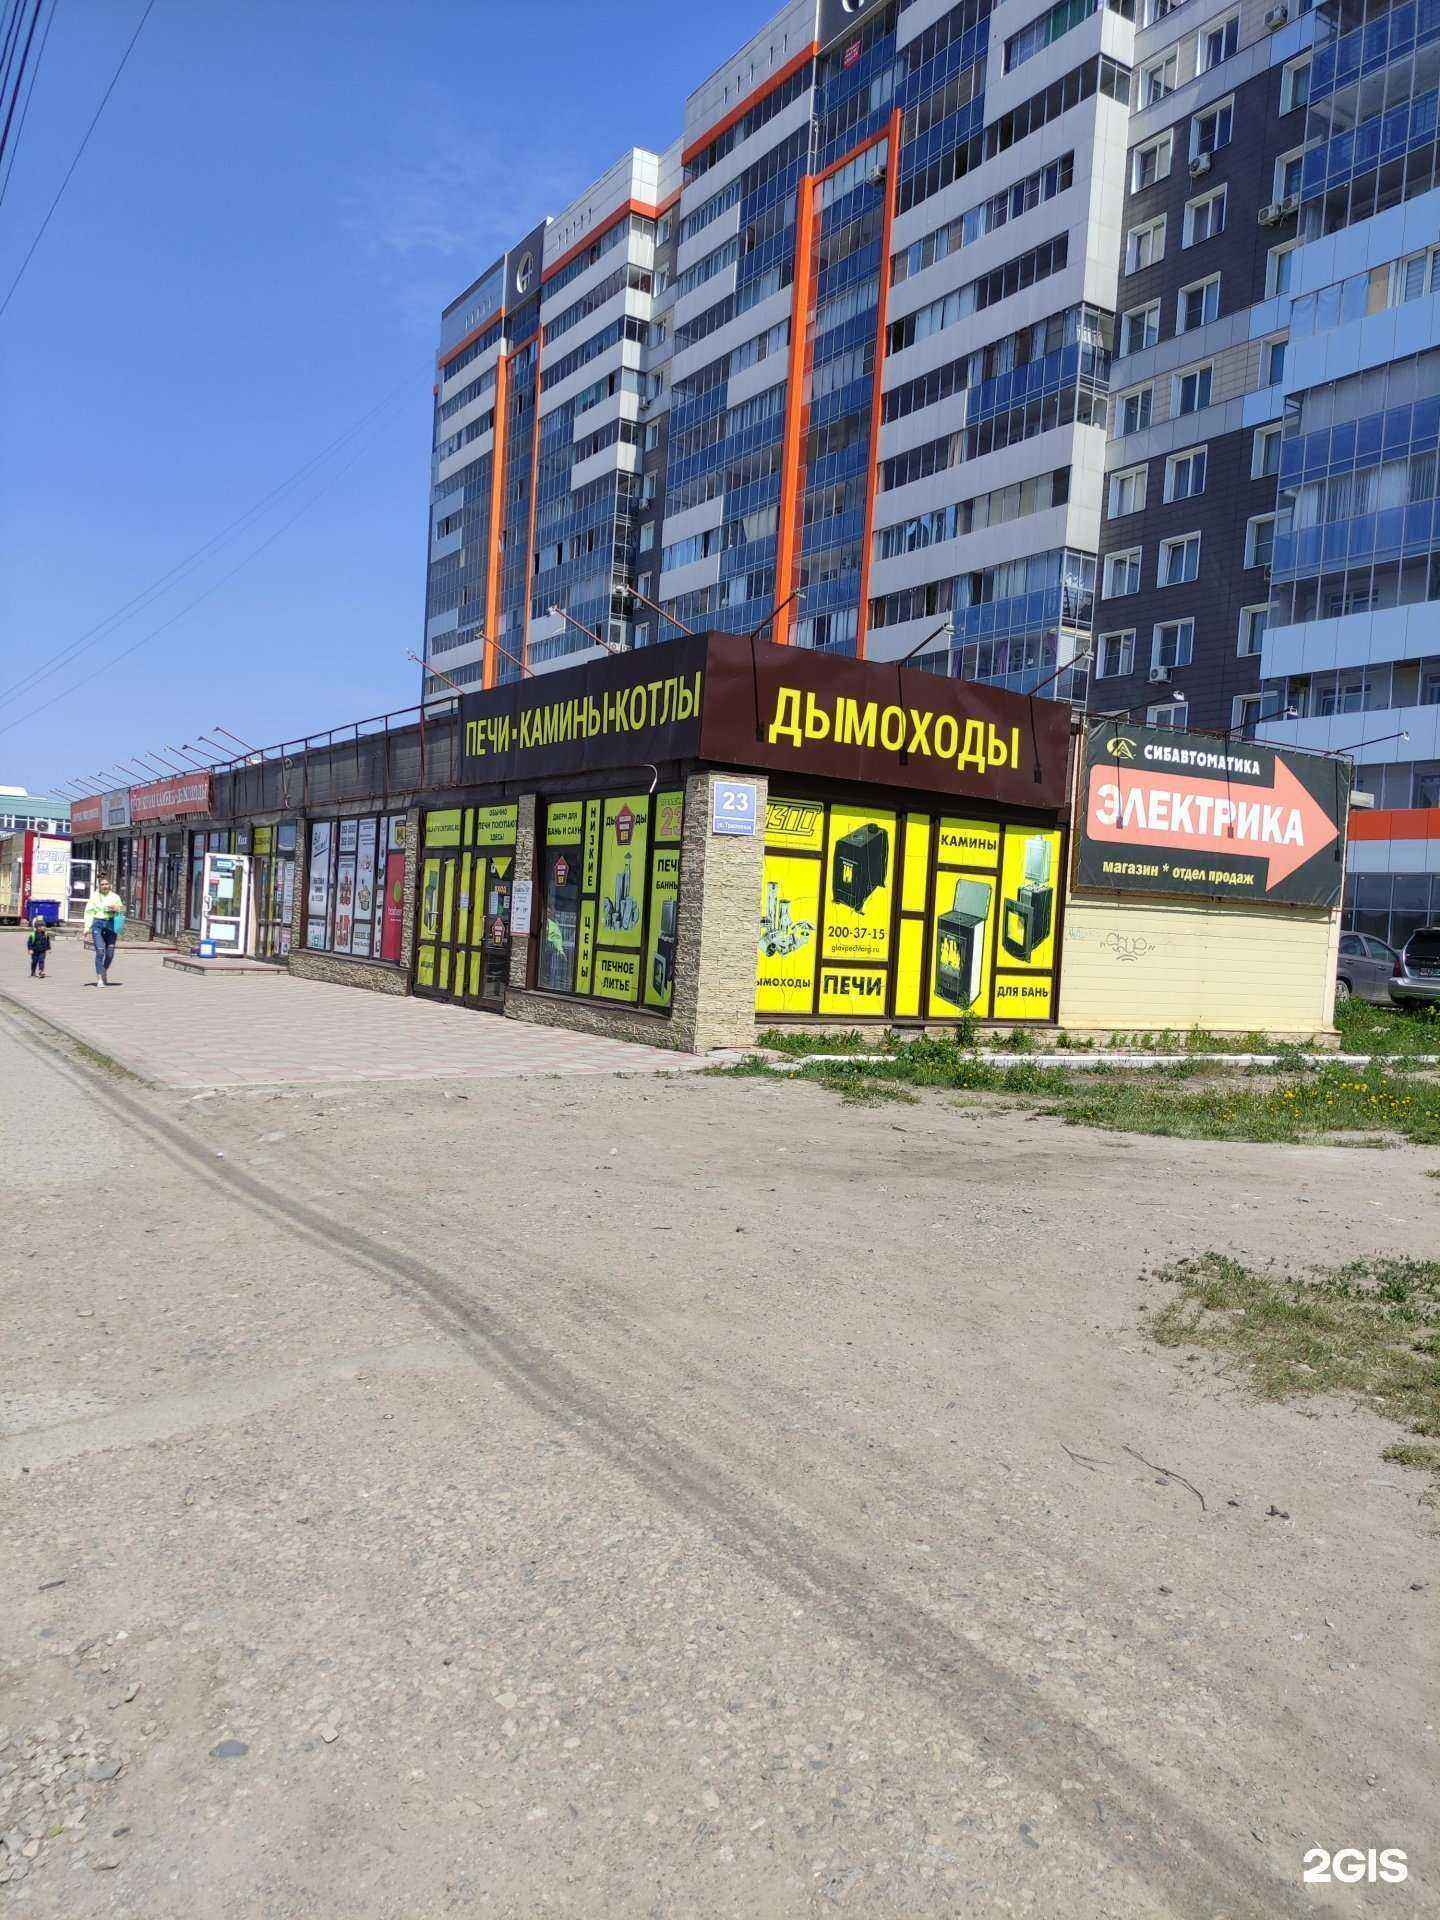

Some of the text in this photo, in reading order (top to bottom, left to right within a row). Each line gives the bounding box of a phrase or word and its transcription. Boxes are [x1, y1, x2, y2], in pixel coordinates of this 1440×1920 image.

[768, 686, 1019, 774] ДЫМОХОДЫ
[1144, 744, 1260, 776] СИБАВТОМАТИКА
[722, 791, 749, 812] 23
[1095, 784, 1305, 847] ЭЛЕКТРИКА
[587, 807, 597, 887] НИЗКИЕ
[940, 834, 998, 850] КАМИНЫ
[1103, 861, 1255, 885] магазин отдел продаж
[828, 925, 885, 940] 200-37-15
[581, 916, 591, 978] ЦЕНЫ
[601, 959, 635, 975] ПЕЧНОЕ
[602, 976, 630, 992] ЛИТЬЕ
[822, 974, 882, 996] ПЕЧИ
[997, 985, 1048, 998] ДЛЯ БАНЬ
